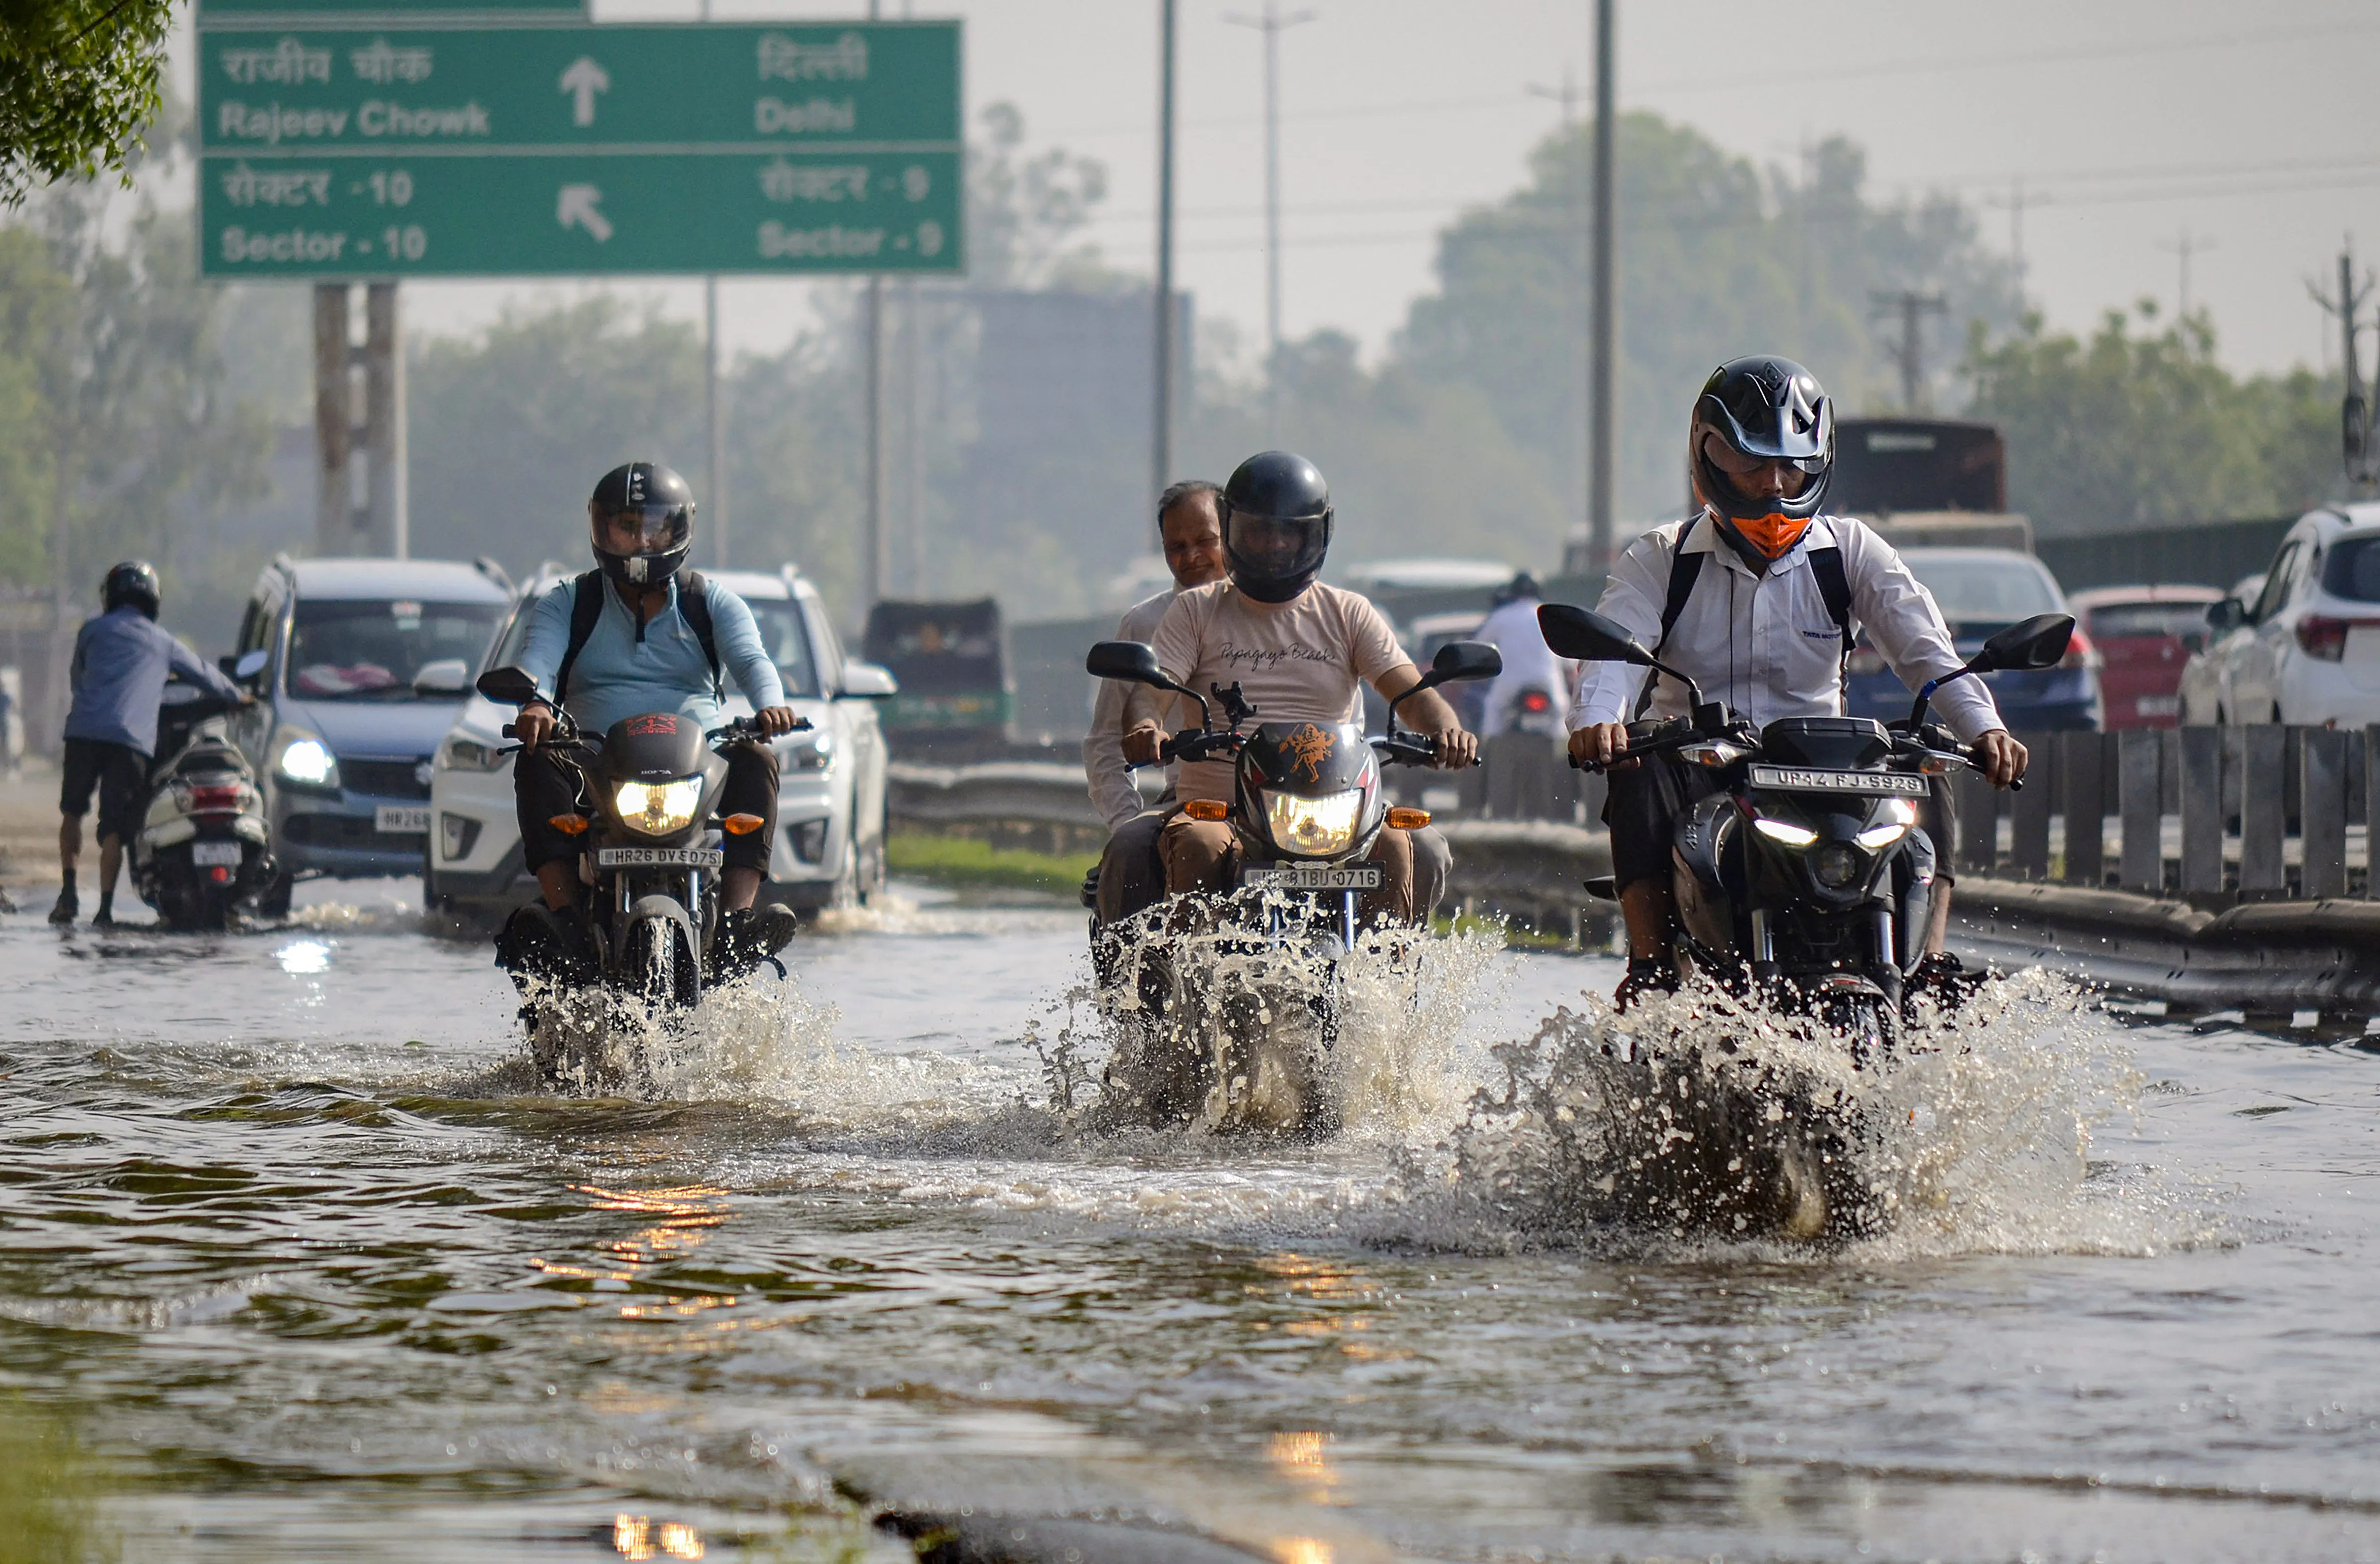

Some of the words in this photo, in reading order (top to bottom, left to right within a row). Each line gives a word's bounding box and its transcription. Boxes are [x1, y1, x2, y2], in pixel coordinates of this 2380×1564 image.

[218, 101, 349, 145] Rajeev
[357, 99, 491, 136] Chowk
[754, 96, 856, 133] Delhi
[221, 225, 347, 263] Sector
[756, 219, 886, 258] Sector
[1218, 641, 1288, 673] Papagayo
